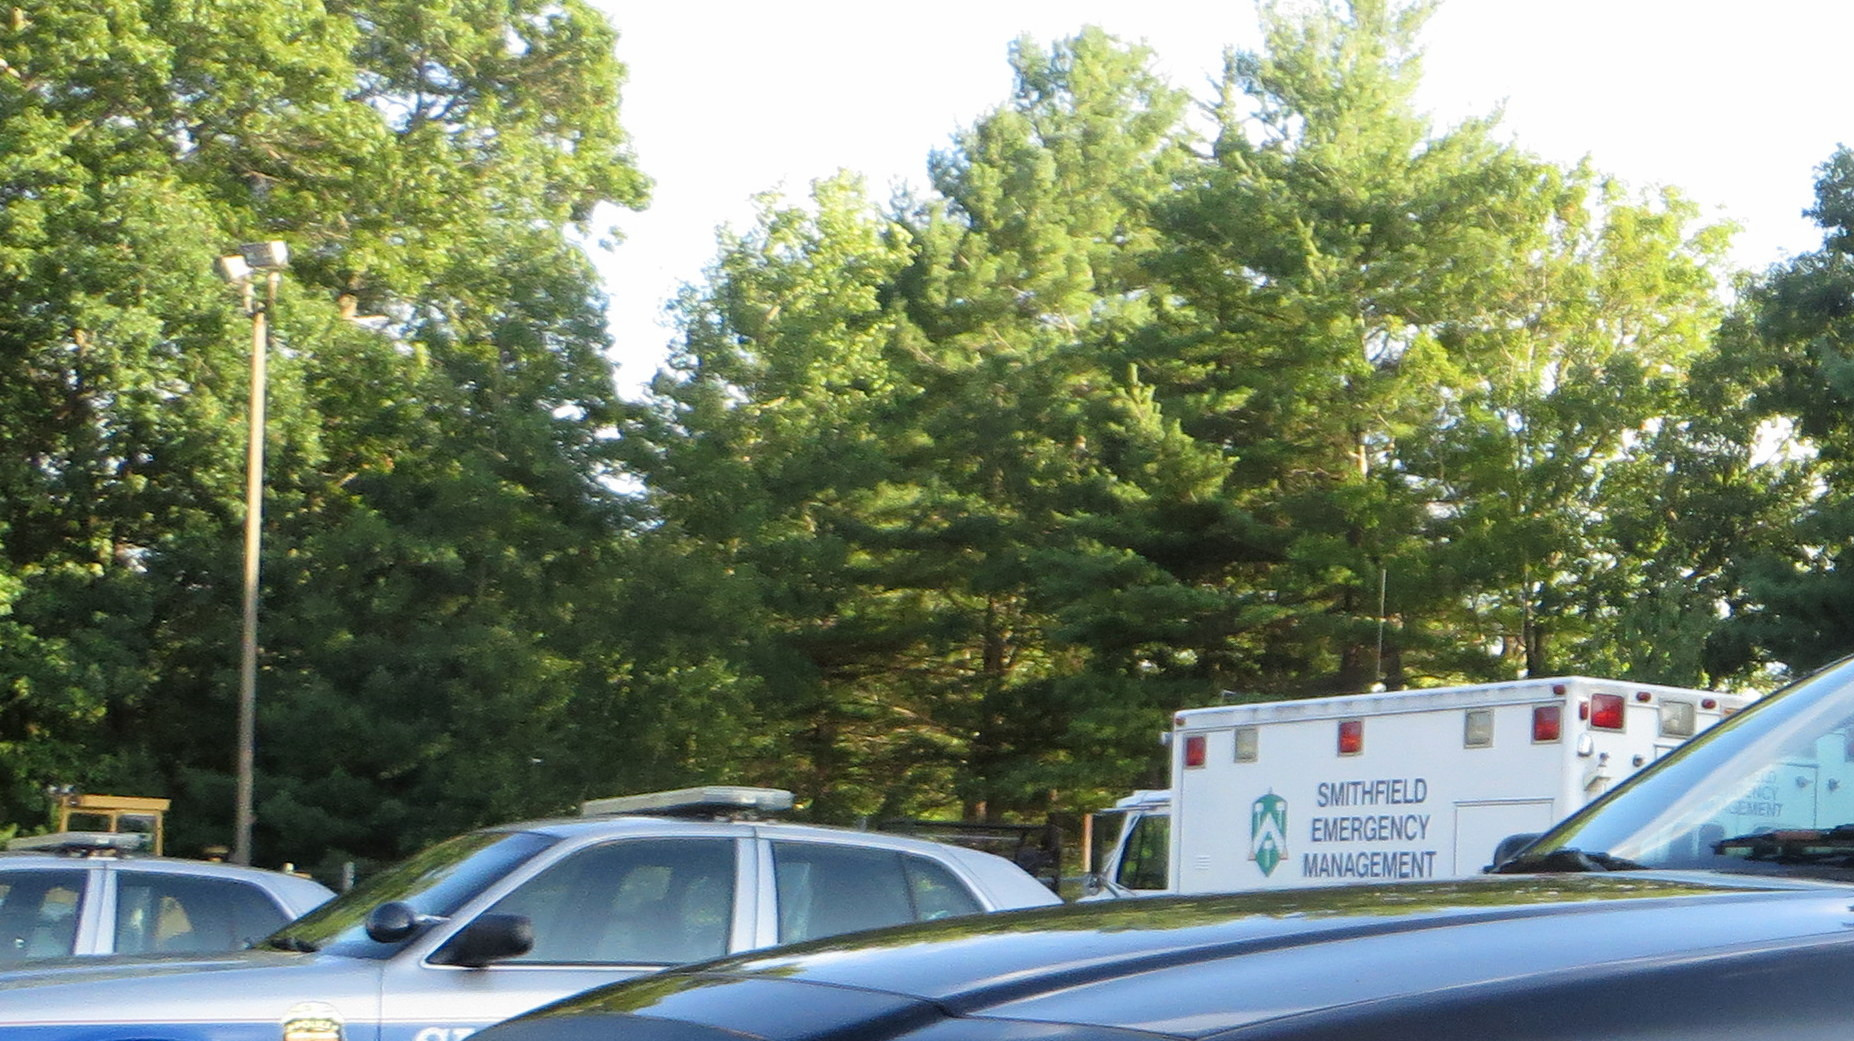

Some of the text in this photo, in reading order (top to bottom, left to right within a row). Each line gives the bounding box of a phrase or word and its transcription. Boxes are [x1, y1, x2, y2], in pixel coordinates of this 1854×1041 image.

[1317, 778, 1428, 807] SMITHFIELD
[1311, 814, 1431, 842] EMERGENCY
[1303, 850, 1437, 878] MANAGEMENT
